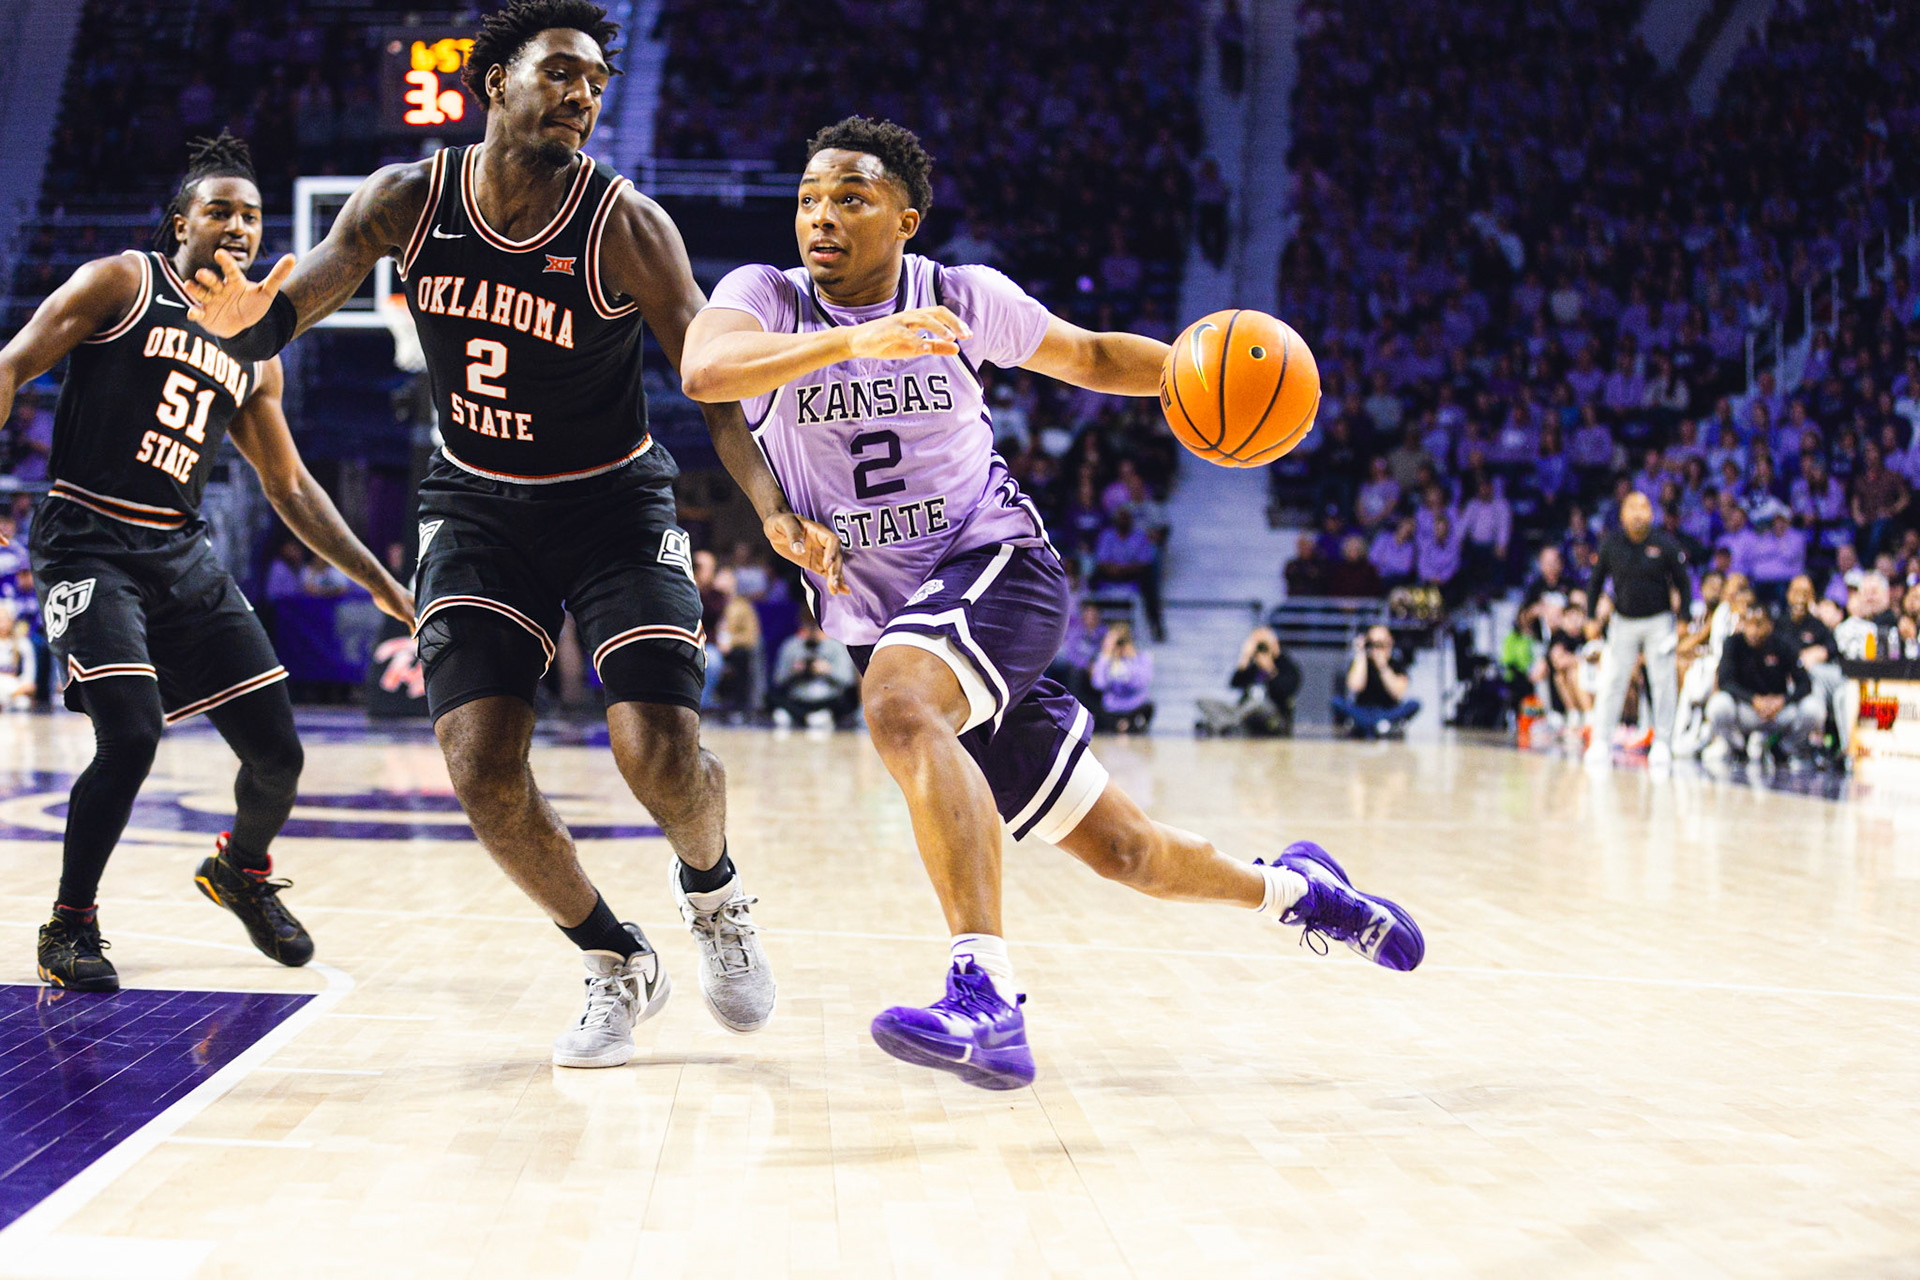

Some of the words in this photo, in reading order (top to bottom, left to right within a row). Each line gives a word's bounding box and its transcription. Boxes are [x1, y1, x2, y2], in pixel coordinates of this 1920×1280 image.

[542, 253, 577, 276] XII
[417, 275, 575, 350] OKLAHOMA
[142, 326, 249, 409] OKLAHOMA
[465, 337, 509, 400] 2
[155, 369, 216, 445] 51
[451, 392, 535, 442] STATE
[796, 373, 954, 427] KANSAS
[135, 429, 201, 485] STATE
[850, 429, 907, 500] 2
[832, 495, 950, 549] STATE
